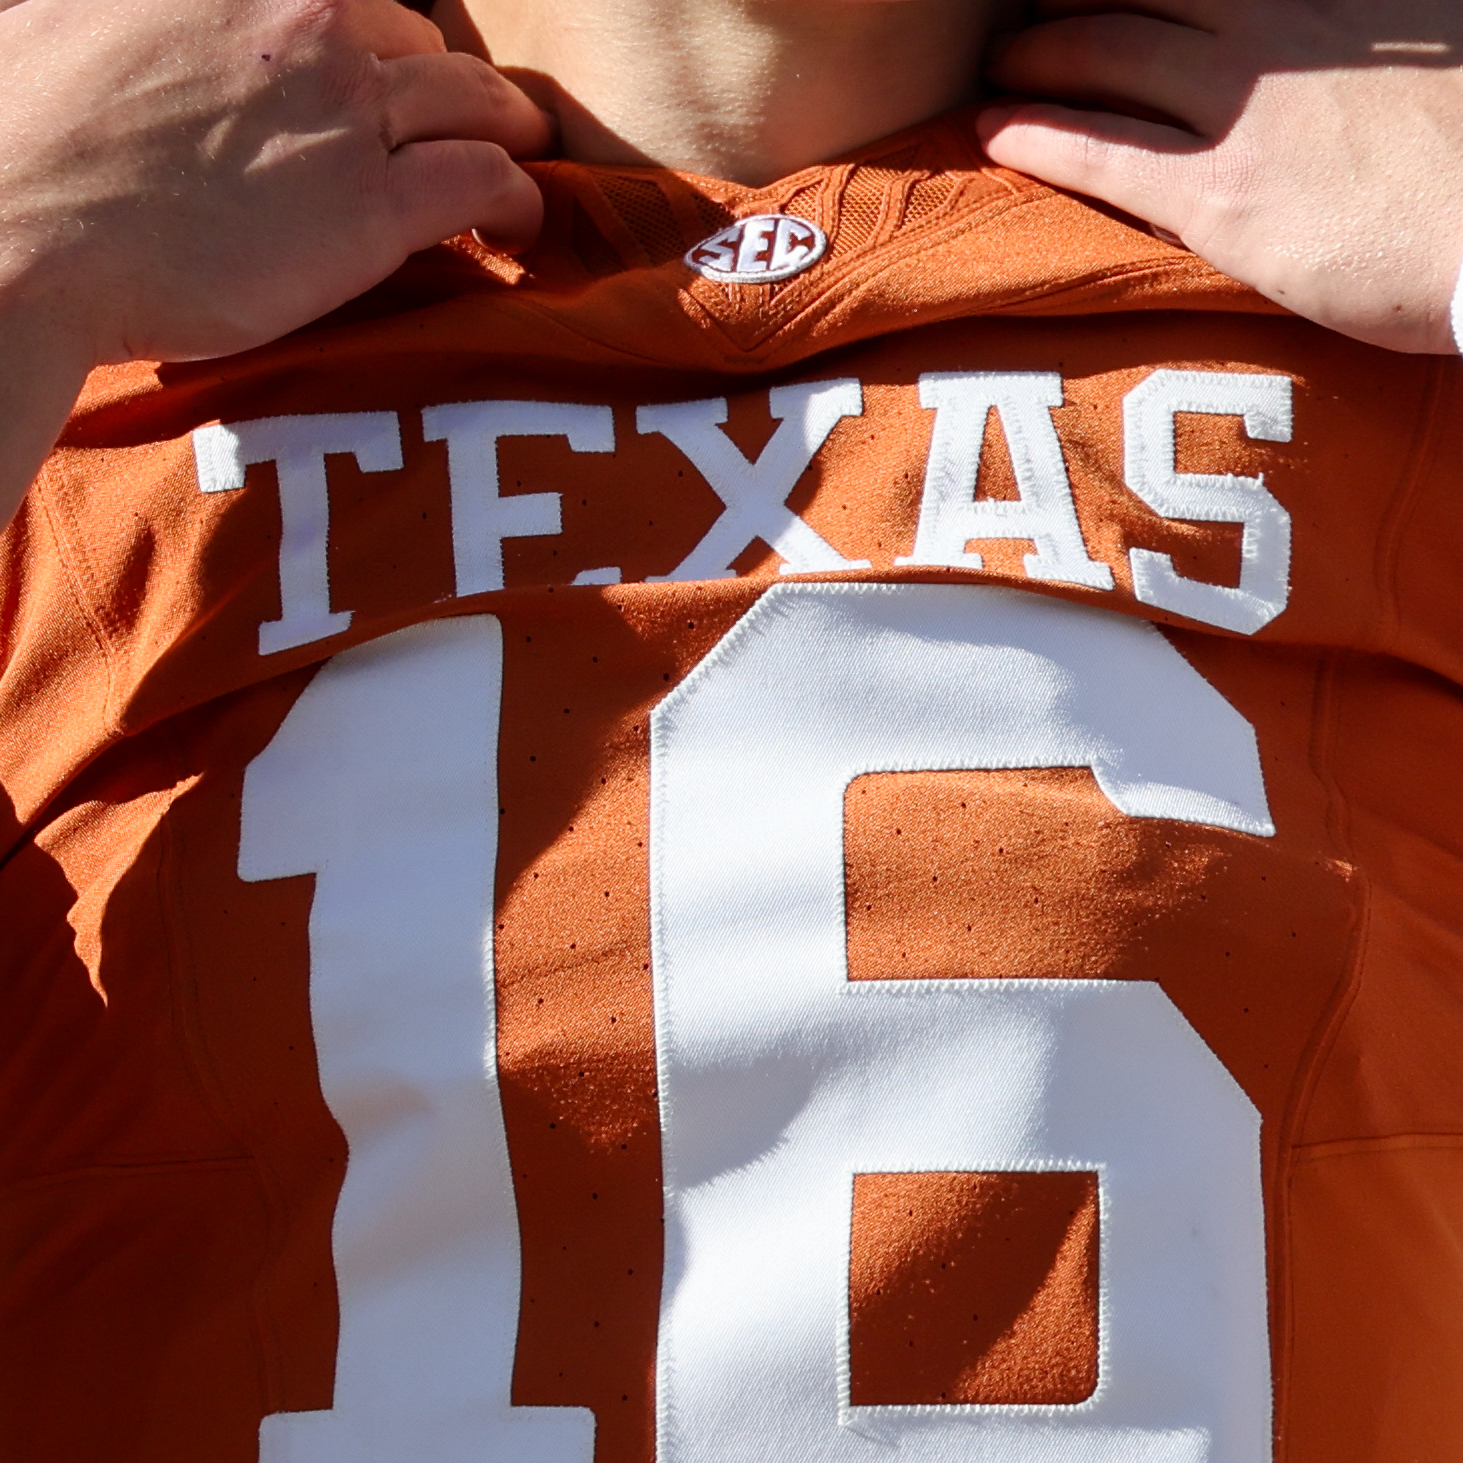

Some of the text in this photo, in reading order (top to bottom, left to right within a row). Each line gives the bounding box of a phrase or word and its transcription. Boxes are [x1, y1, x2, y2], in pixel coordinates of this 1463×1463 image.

[699, 218, 812, 272] SEC
[195, 370, 1294, 656] TEXAS
[238, 583, 1277, 1463] 16
